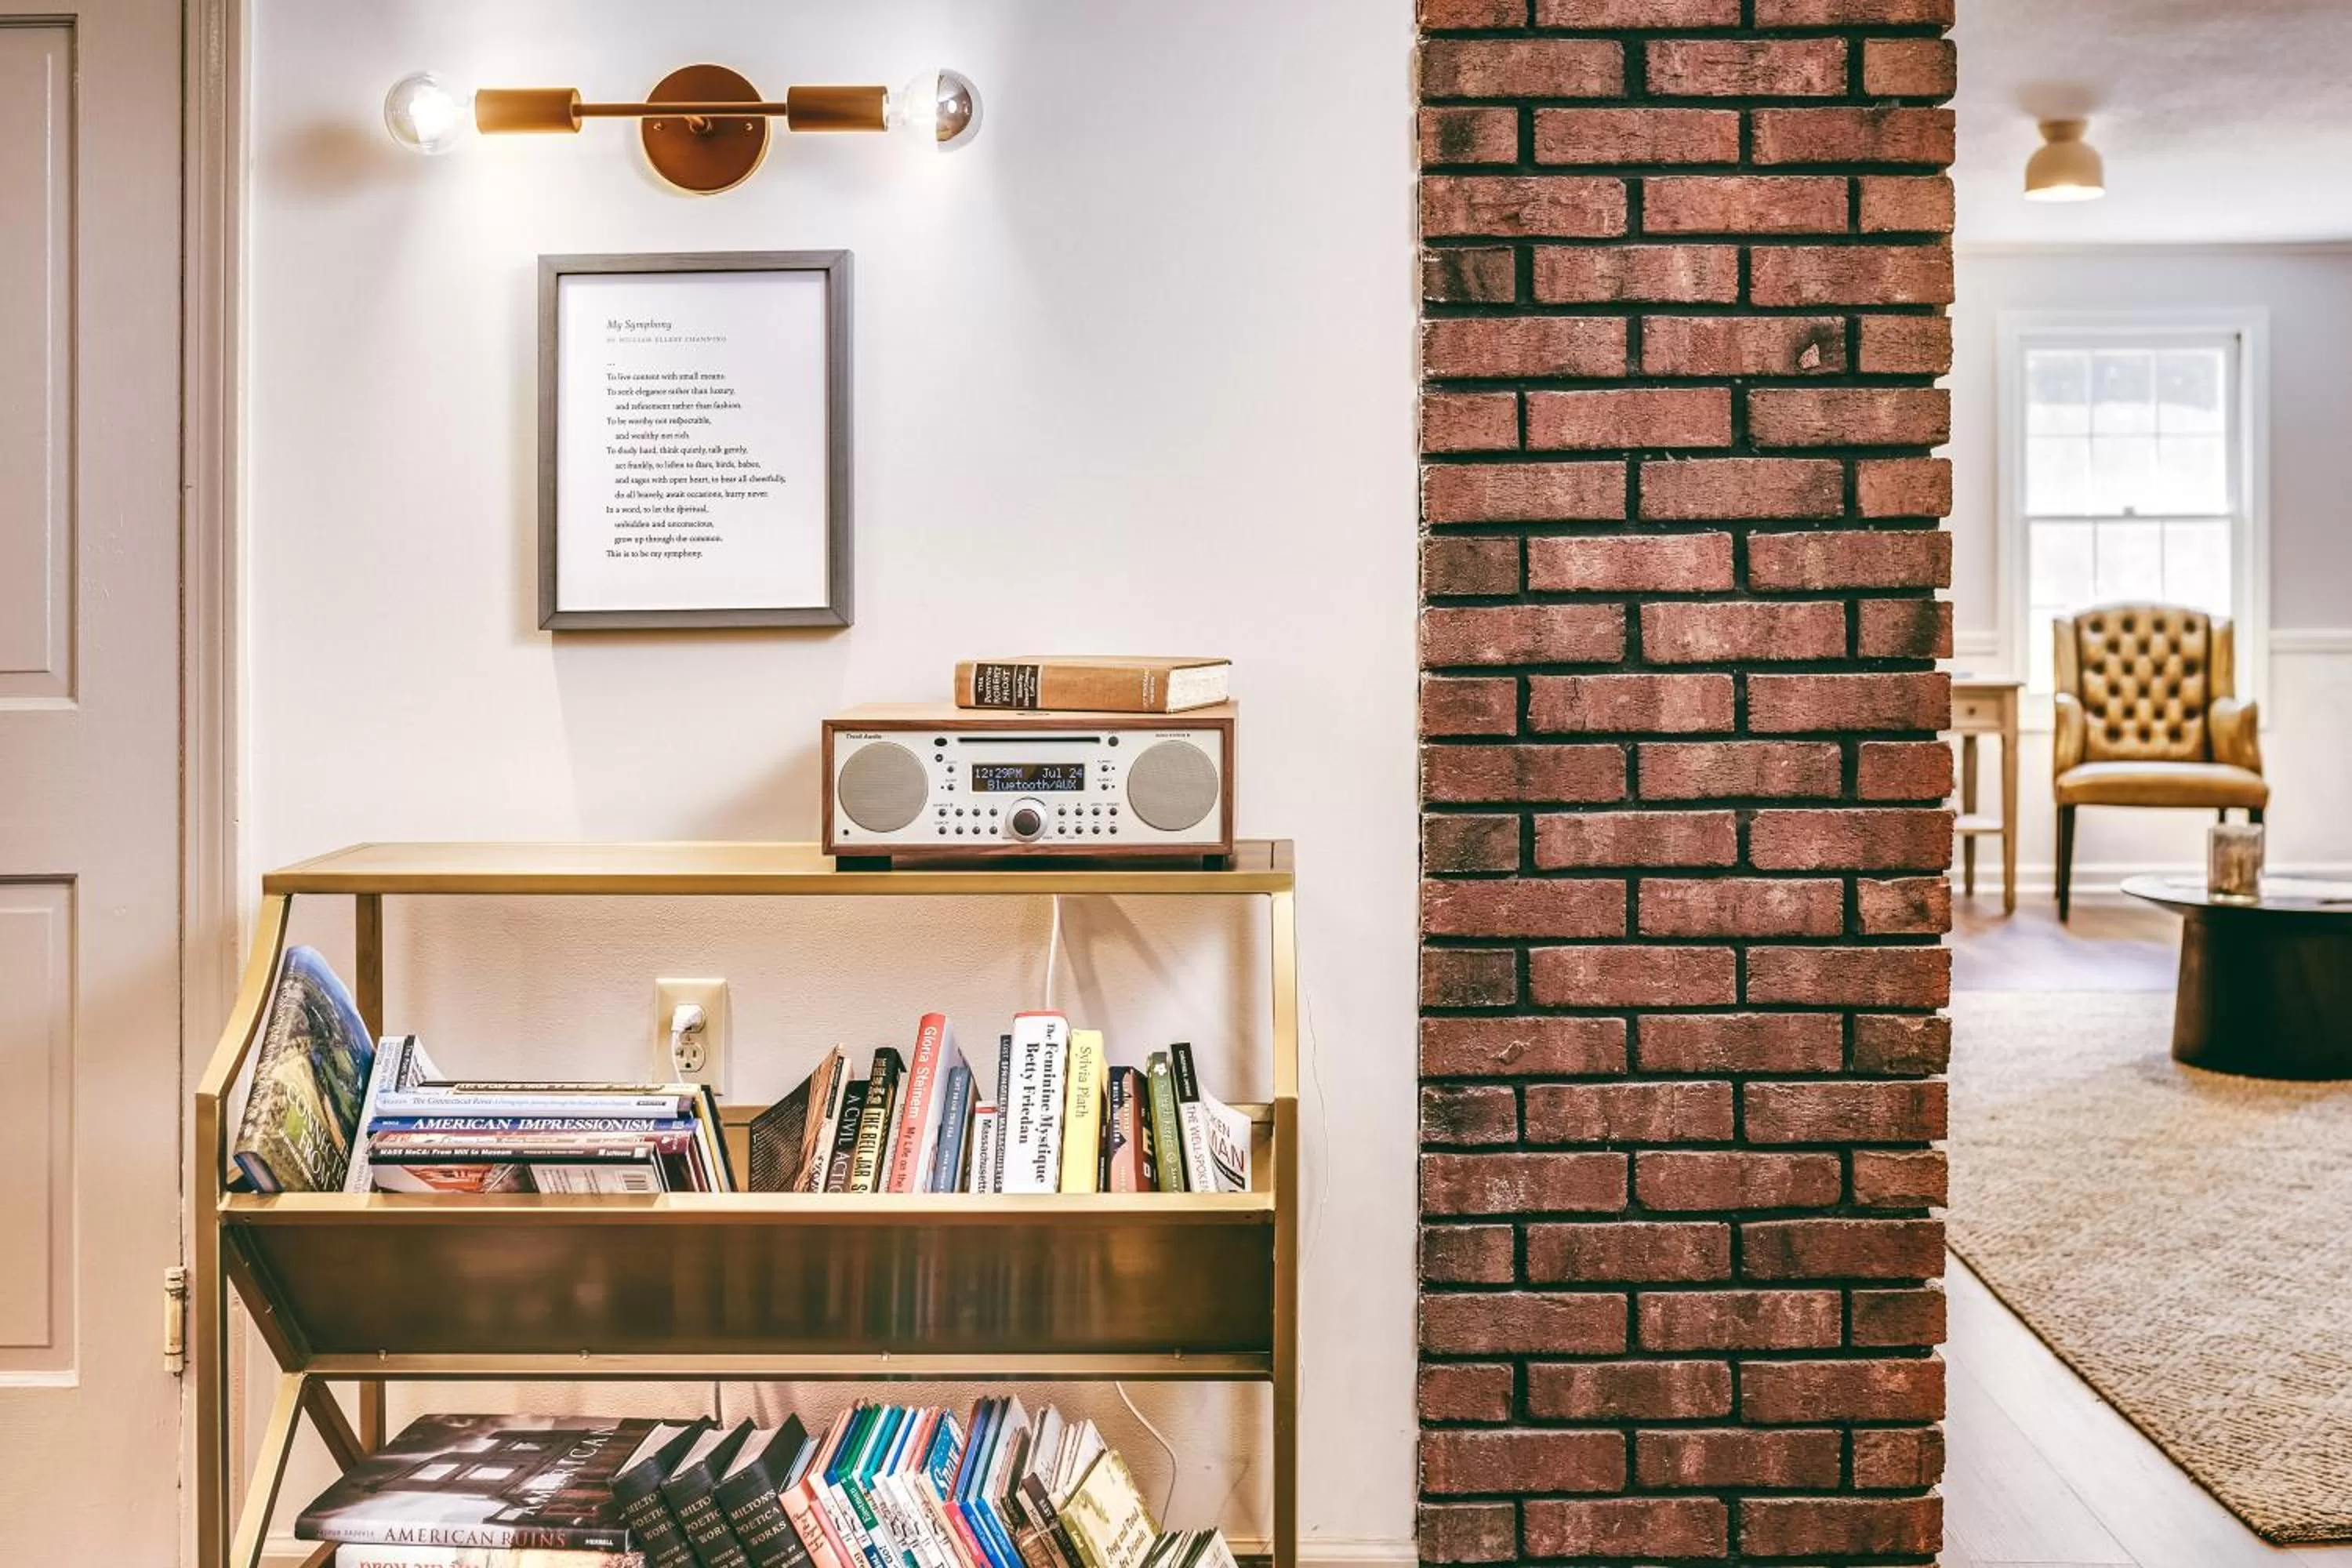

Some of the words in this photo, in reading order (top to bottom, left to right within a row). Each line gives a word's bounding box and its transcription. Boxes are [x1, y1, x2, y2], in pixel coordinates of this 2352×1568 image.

[607, 319, 623, 331] My
[625, 319, 672, 332] Symphony
[635, 387, 666, 397] elegance
[672, 401, 693, 410] rather
[629, 417, 653, 426] worthy
[615, 431, 629, 440] and
[631, 431, 659, 441] wealthy
[659, 445, 680, 454] think
[708, 445, 722, 454] talk
[670, 477, 687, 485] open
[739, 474, 747, 483] all
[626, 490, 635, 499] all
[666, 490, 684, 499] await
[725, 490, 745, 500] hurry
[652, 505, 662, 514] let
[662, 505, 674, 514] the
[614, 536, 633, 545] grow
[646, 534, 674, 545] through
[993, 666, 1002, 704] ROBERT
[976, 769, 1022, 779] 12:29PM
[1043, 768, 1062, 779] Jul
[1071, 768, 1083, 779] 24
[988, 779, 1076, 789] Bluetooth/AUX
[1047, 1022, 1056, 1040] The
[918, 1026, 938, 1063] Gloria
[1020, 1043, 1040, 1080] Betty
[1075, 1047, 1092, 1083] Sylvia
[1040, 1042, 1058, 1112] Feminine
[848, 1094, 862, 1103] A
[906, 1065, 931, 1120] Steinem
[1076, 1086, 1090, 1118] Plath
[862, 1111, 881, 1129] THE
[1019, 1084, 1036, 1144] Friedan
[1185, 1106, 1198, 1124] THE
[412, 1119, 511, 1130] AMERICAN
[518, 1119, 655, 1131] IMPRESSIONISM
[838, 1108, 860, 1145] CIVIL
[904, 1127, 916, 1139] My
[858, 1133, 877, 1154] BELL
[902, 1140, 913, 1158] Life
[1033, 1113, 1054, 1183] Mystique
[854, 1156, 873, 1177] JAR
[900, 1160, 908, 1169] on
[896, 1174, 907, 1188] the
[627, 1493, 657, 1512] MILTO
[681, 1496, 711, 1517] MILTO
[385, 1528, 494, 1544] AMERICAN
[502, 1530, 566, 1547] RUINS
[750, 1520, 787, 1545] WORKS
